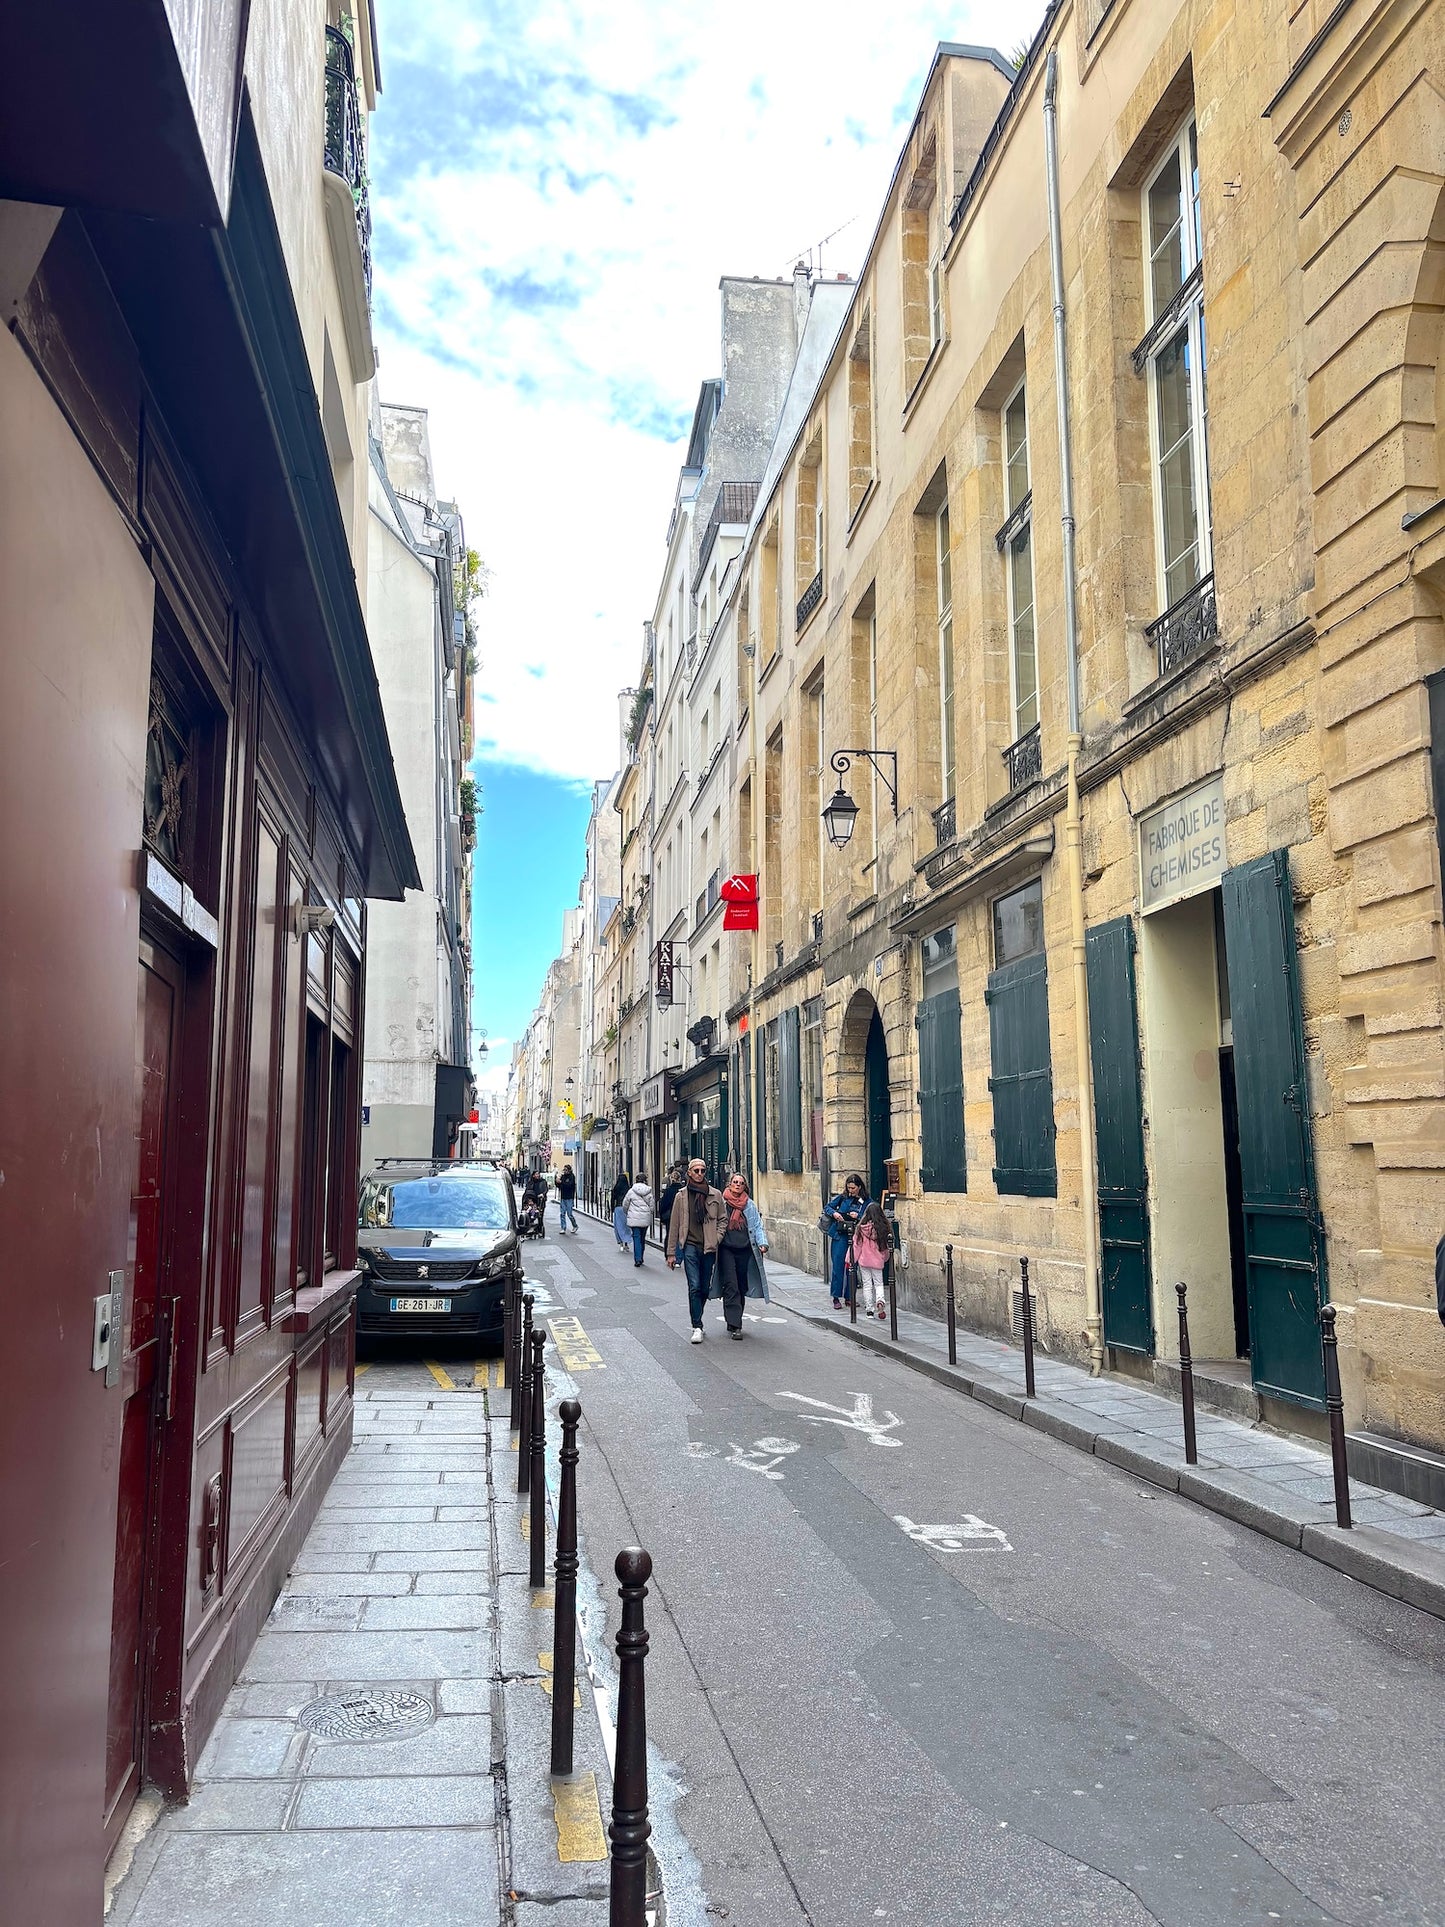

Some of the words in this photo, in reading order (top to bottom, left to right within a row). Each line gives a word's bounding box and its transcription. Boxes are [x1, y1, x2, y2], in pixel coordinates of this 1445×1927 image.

[1149, 808, 1200, 857] FABRIQUE
[1203, 797, 1220, 829] DE
[1150, 836, 1222, 889] CHEMISES
